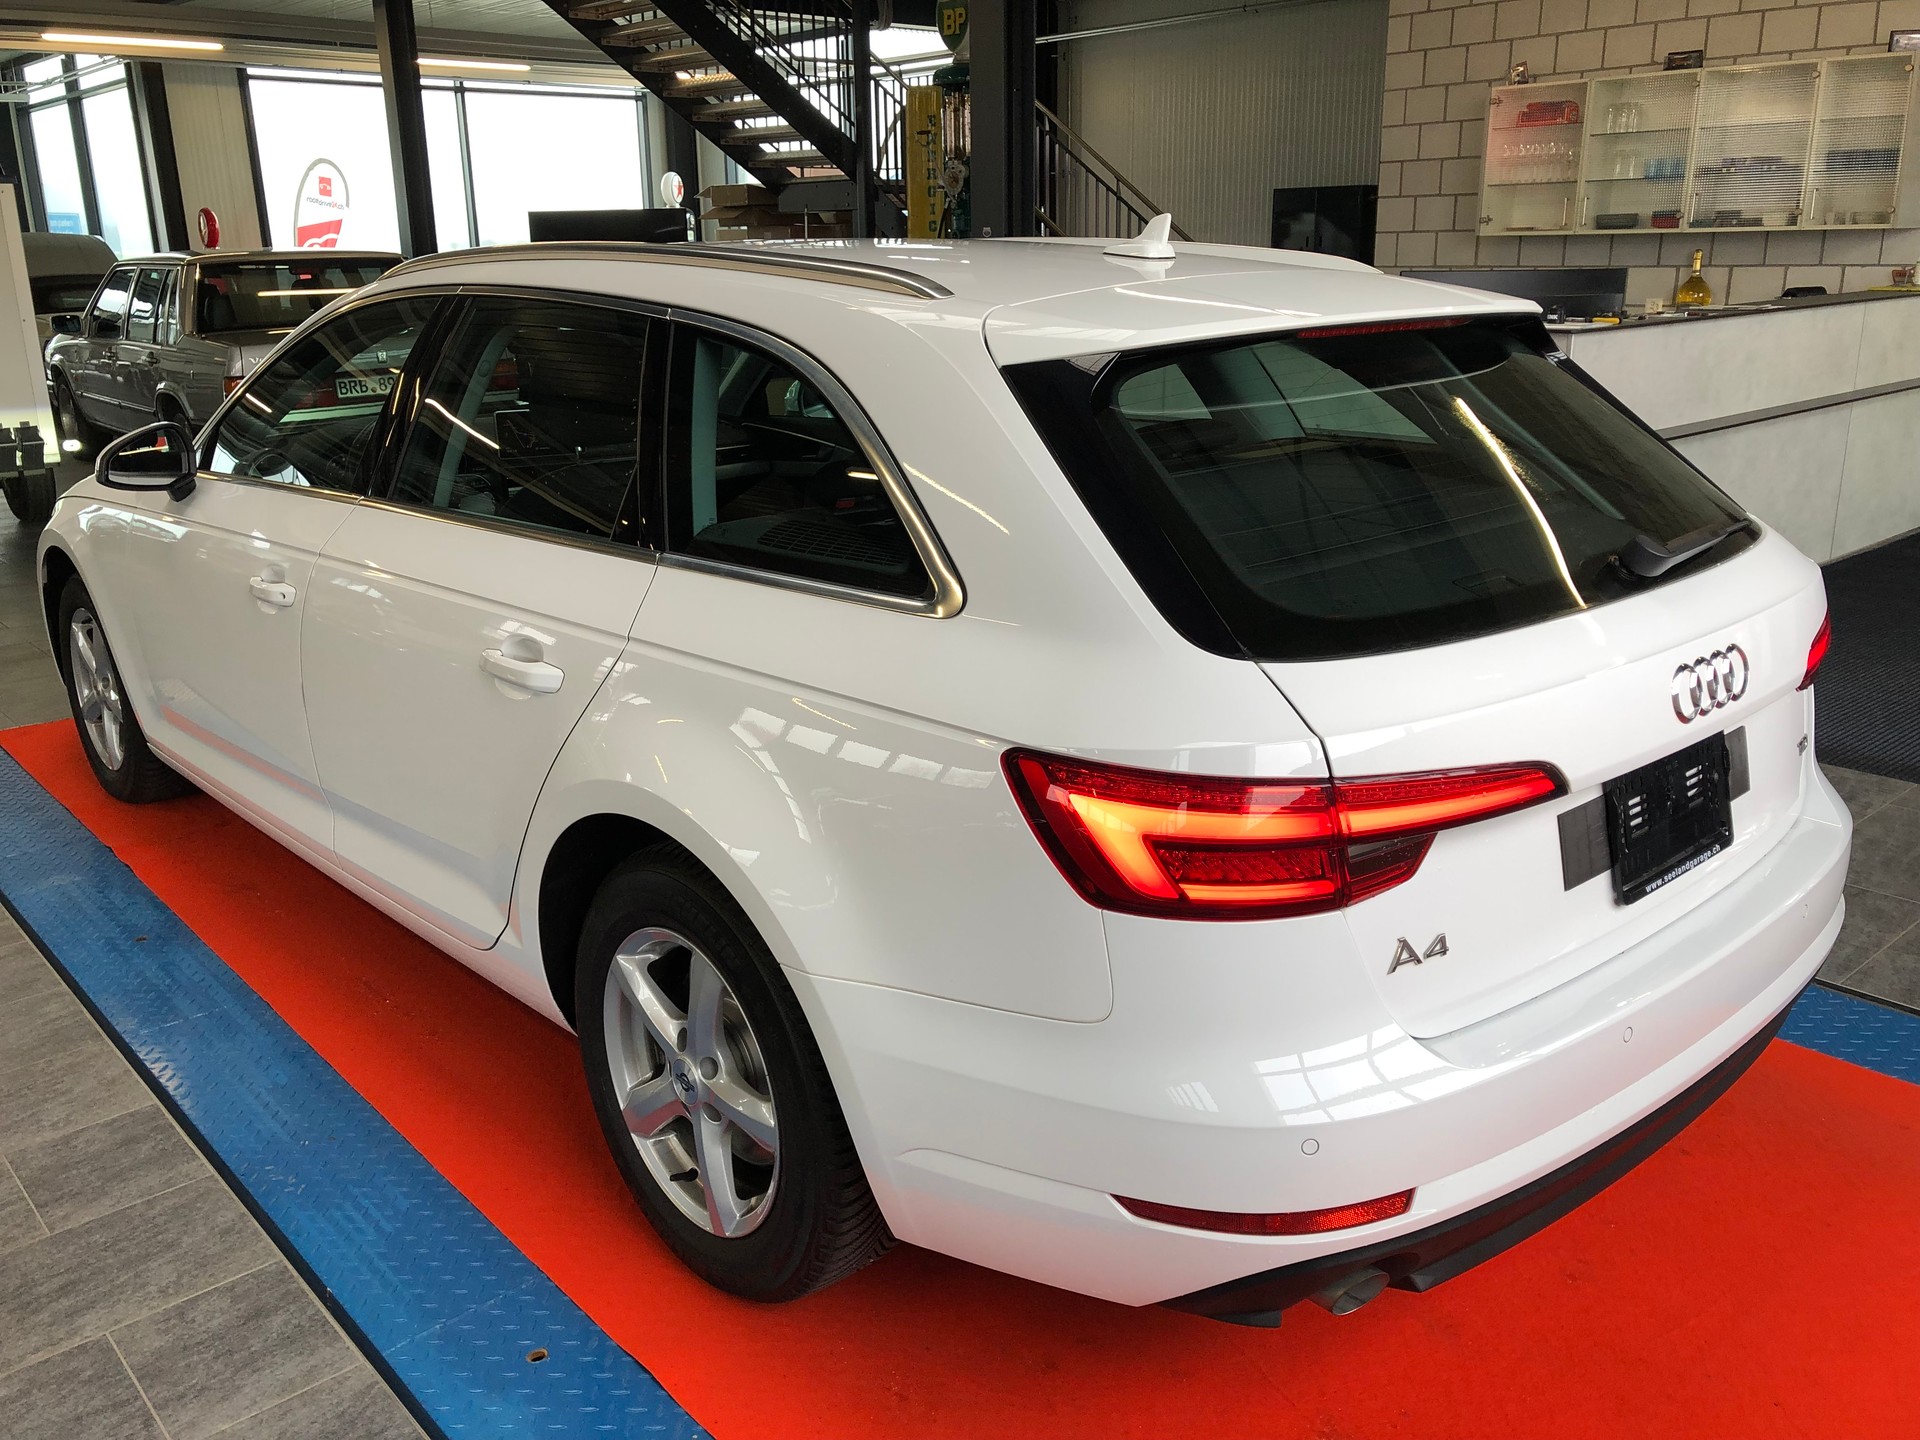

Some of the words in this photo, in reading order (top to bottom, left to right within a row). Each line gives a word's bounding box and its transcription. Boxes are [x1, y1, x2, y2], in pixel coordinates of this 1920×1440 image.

[943, 7, 966, 36] BP
[338, 380, 369, 396] BRB
[1645, 844, 1721, 893] www.seelandgarage.ch
[1386, 932, 1449, 975] A4
